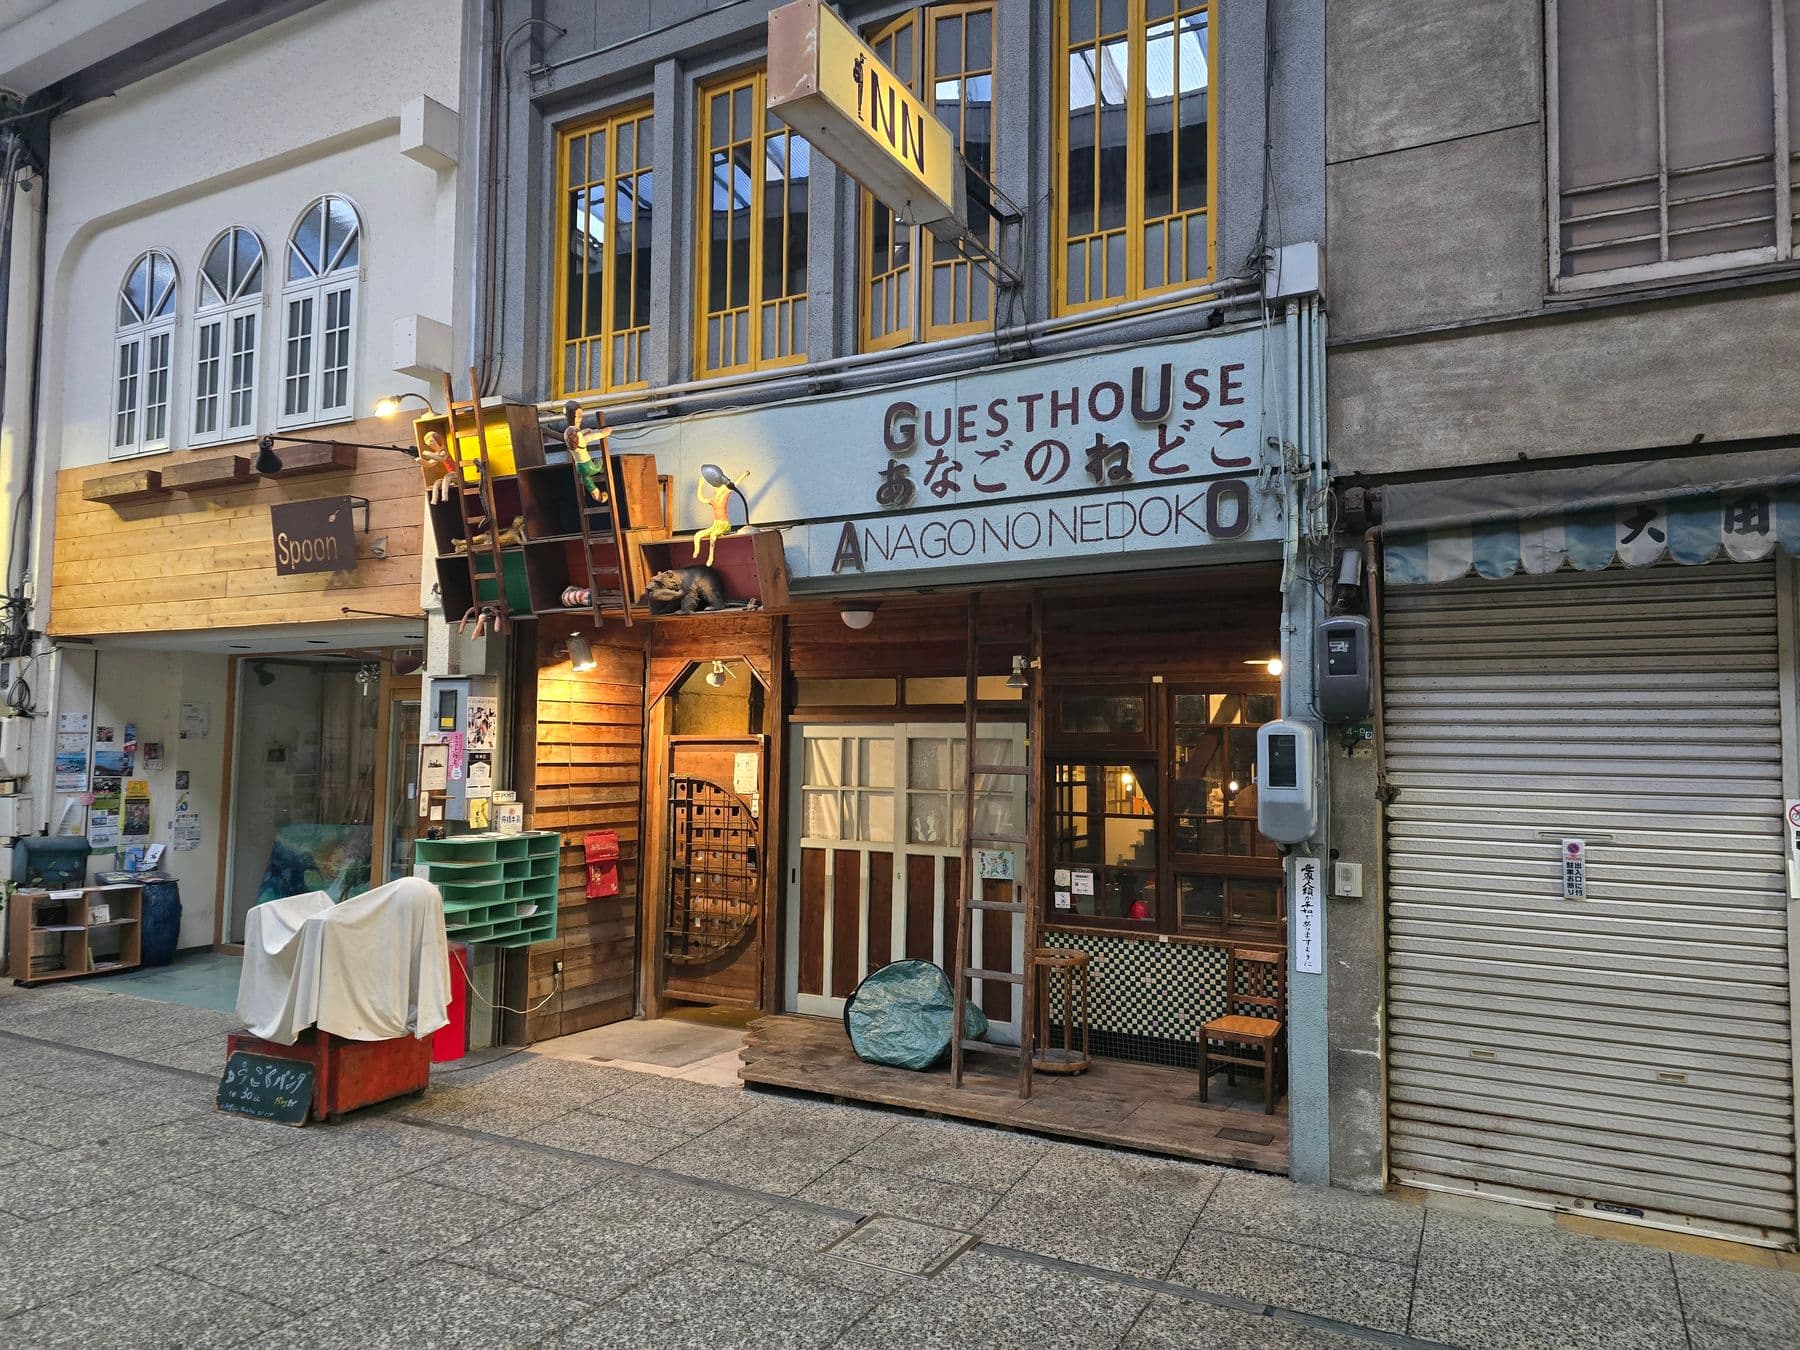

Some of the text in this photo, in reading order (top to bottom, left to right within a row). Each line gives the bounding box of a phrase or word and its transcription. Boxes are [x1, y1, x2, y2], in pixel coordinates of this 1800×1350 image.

[883, 362, 1246, 454] GUESTHOUSE
[875, 418, 1252, 509] あなごのねどこ
[277, 532, 338, 570] Spoon
